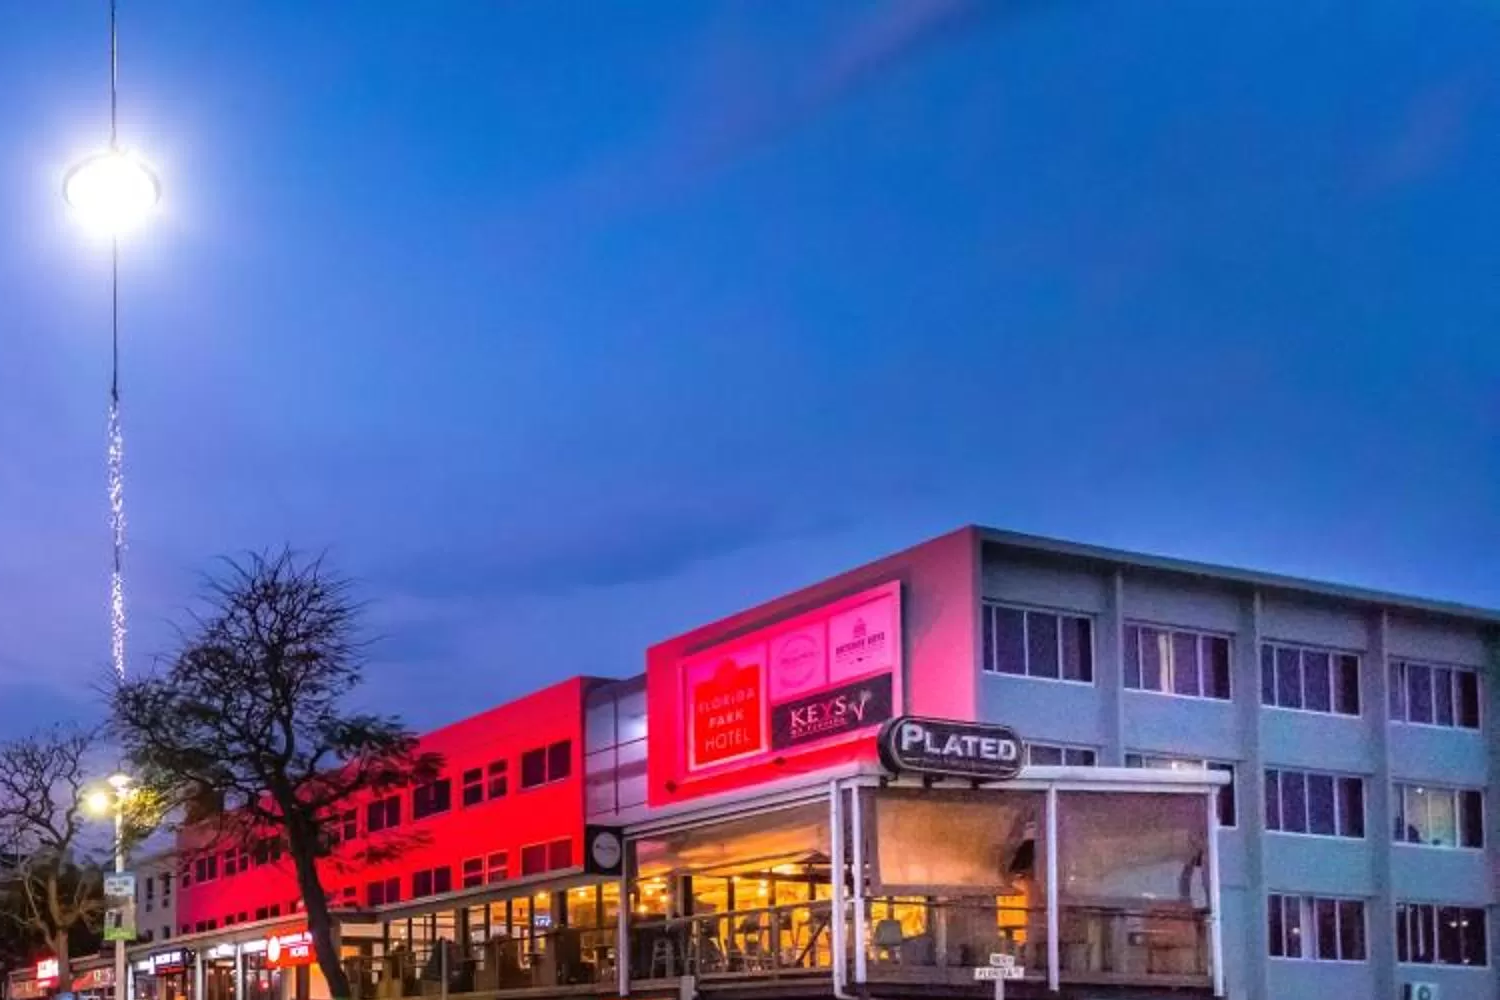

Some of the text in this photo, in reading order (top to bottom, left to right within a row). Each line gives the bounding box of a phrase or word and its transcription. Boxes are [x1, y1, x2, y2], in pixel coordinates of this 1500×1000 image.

[699, 687, 756, 713] FLORIDA
[790, 695, 847, 728] KEYS
[708, 708, 745, 729] PARK
[705, 727, 751, 752] HOTEL
[901, 723, 1017, 761] PLATED
